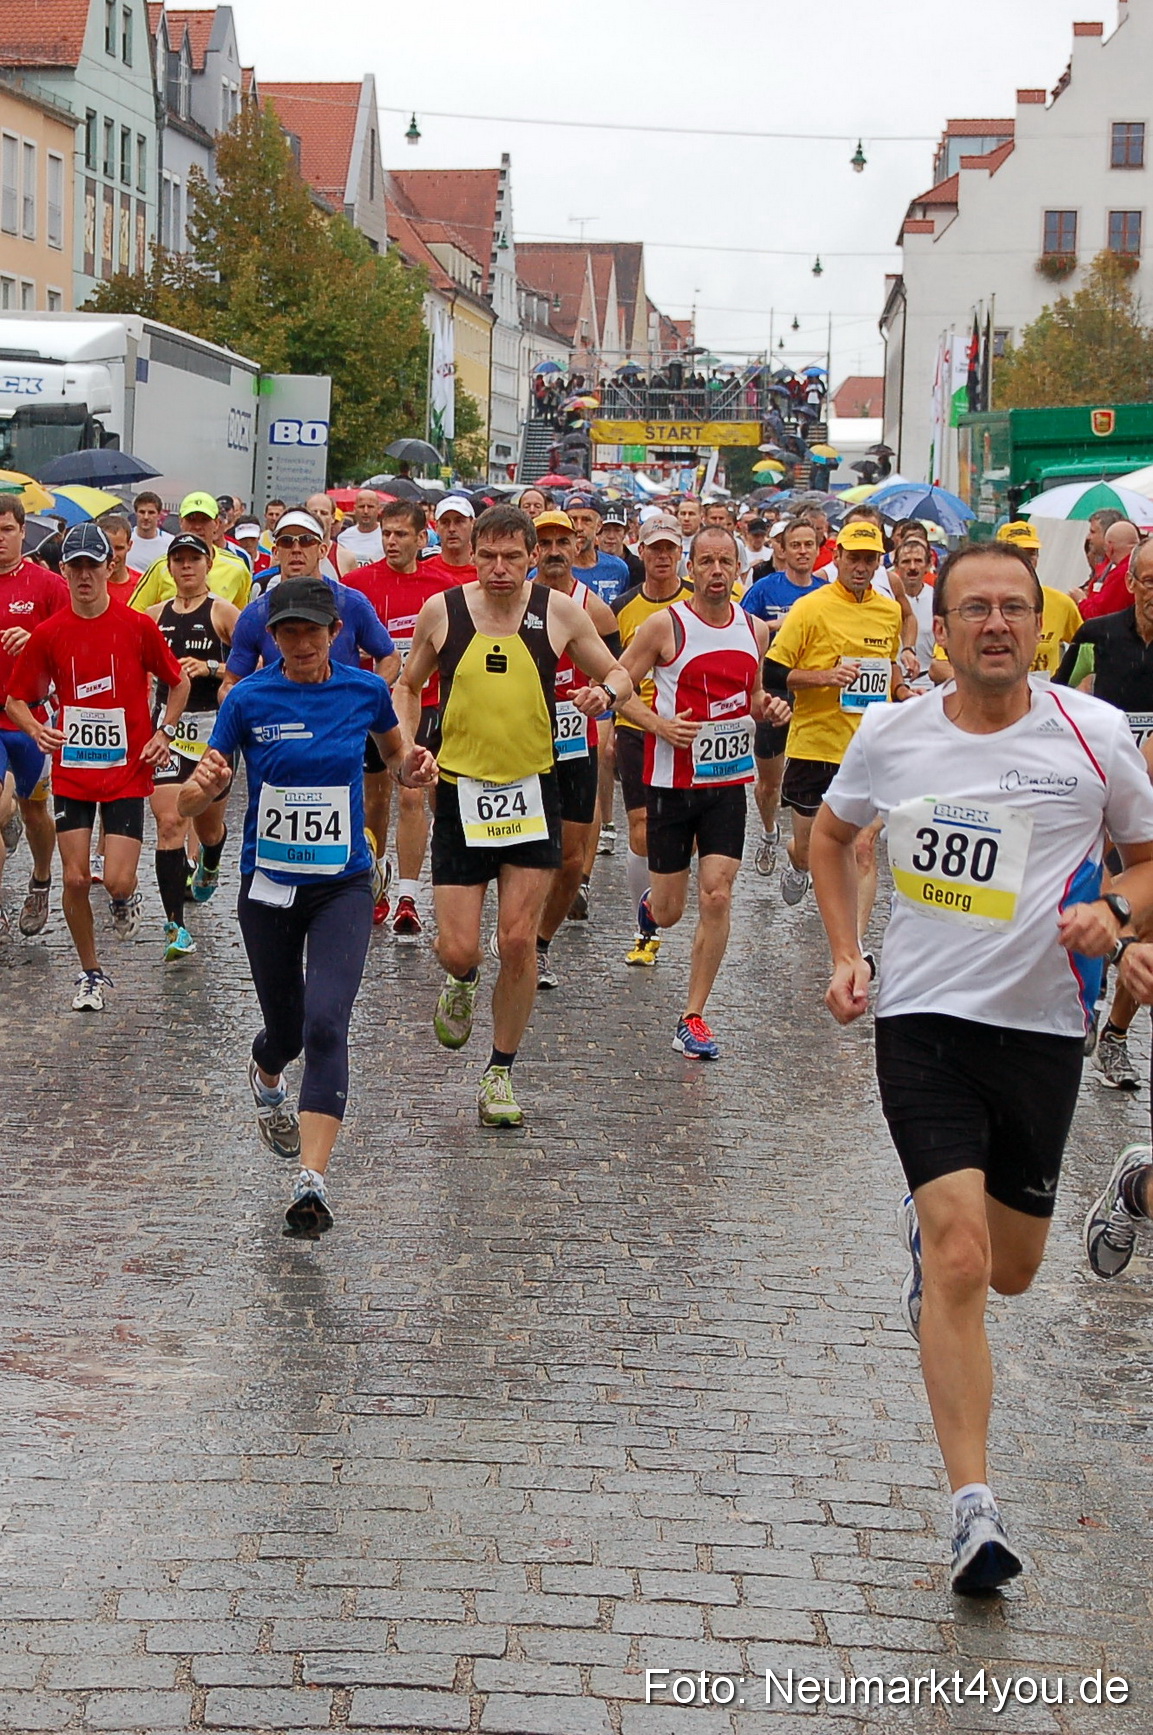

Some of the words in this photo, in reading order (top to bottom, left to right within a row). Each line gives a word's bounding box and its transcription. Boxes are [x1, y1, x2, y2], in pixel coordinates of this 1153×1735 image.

[645, 426, 703, 440] START
[68, 723, 121, 747] 2665
[700, 733, 749, 761] 2033
[76, 750, 110, 760] Michael
[477, 791, 527, 820] 624
[934, 804, 989, 823] BOCK
[265, 808, 342, 842] 2154
[487, 822, 521, 837] Harald
[287, 847, 315, 861] Gabi
[912, 827, 999, 882] 380
[922, 883, 972, 912] Georg
